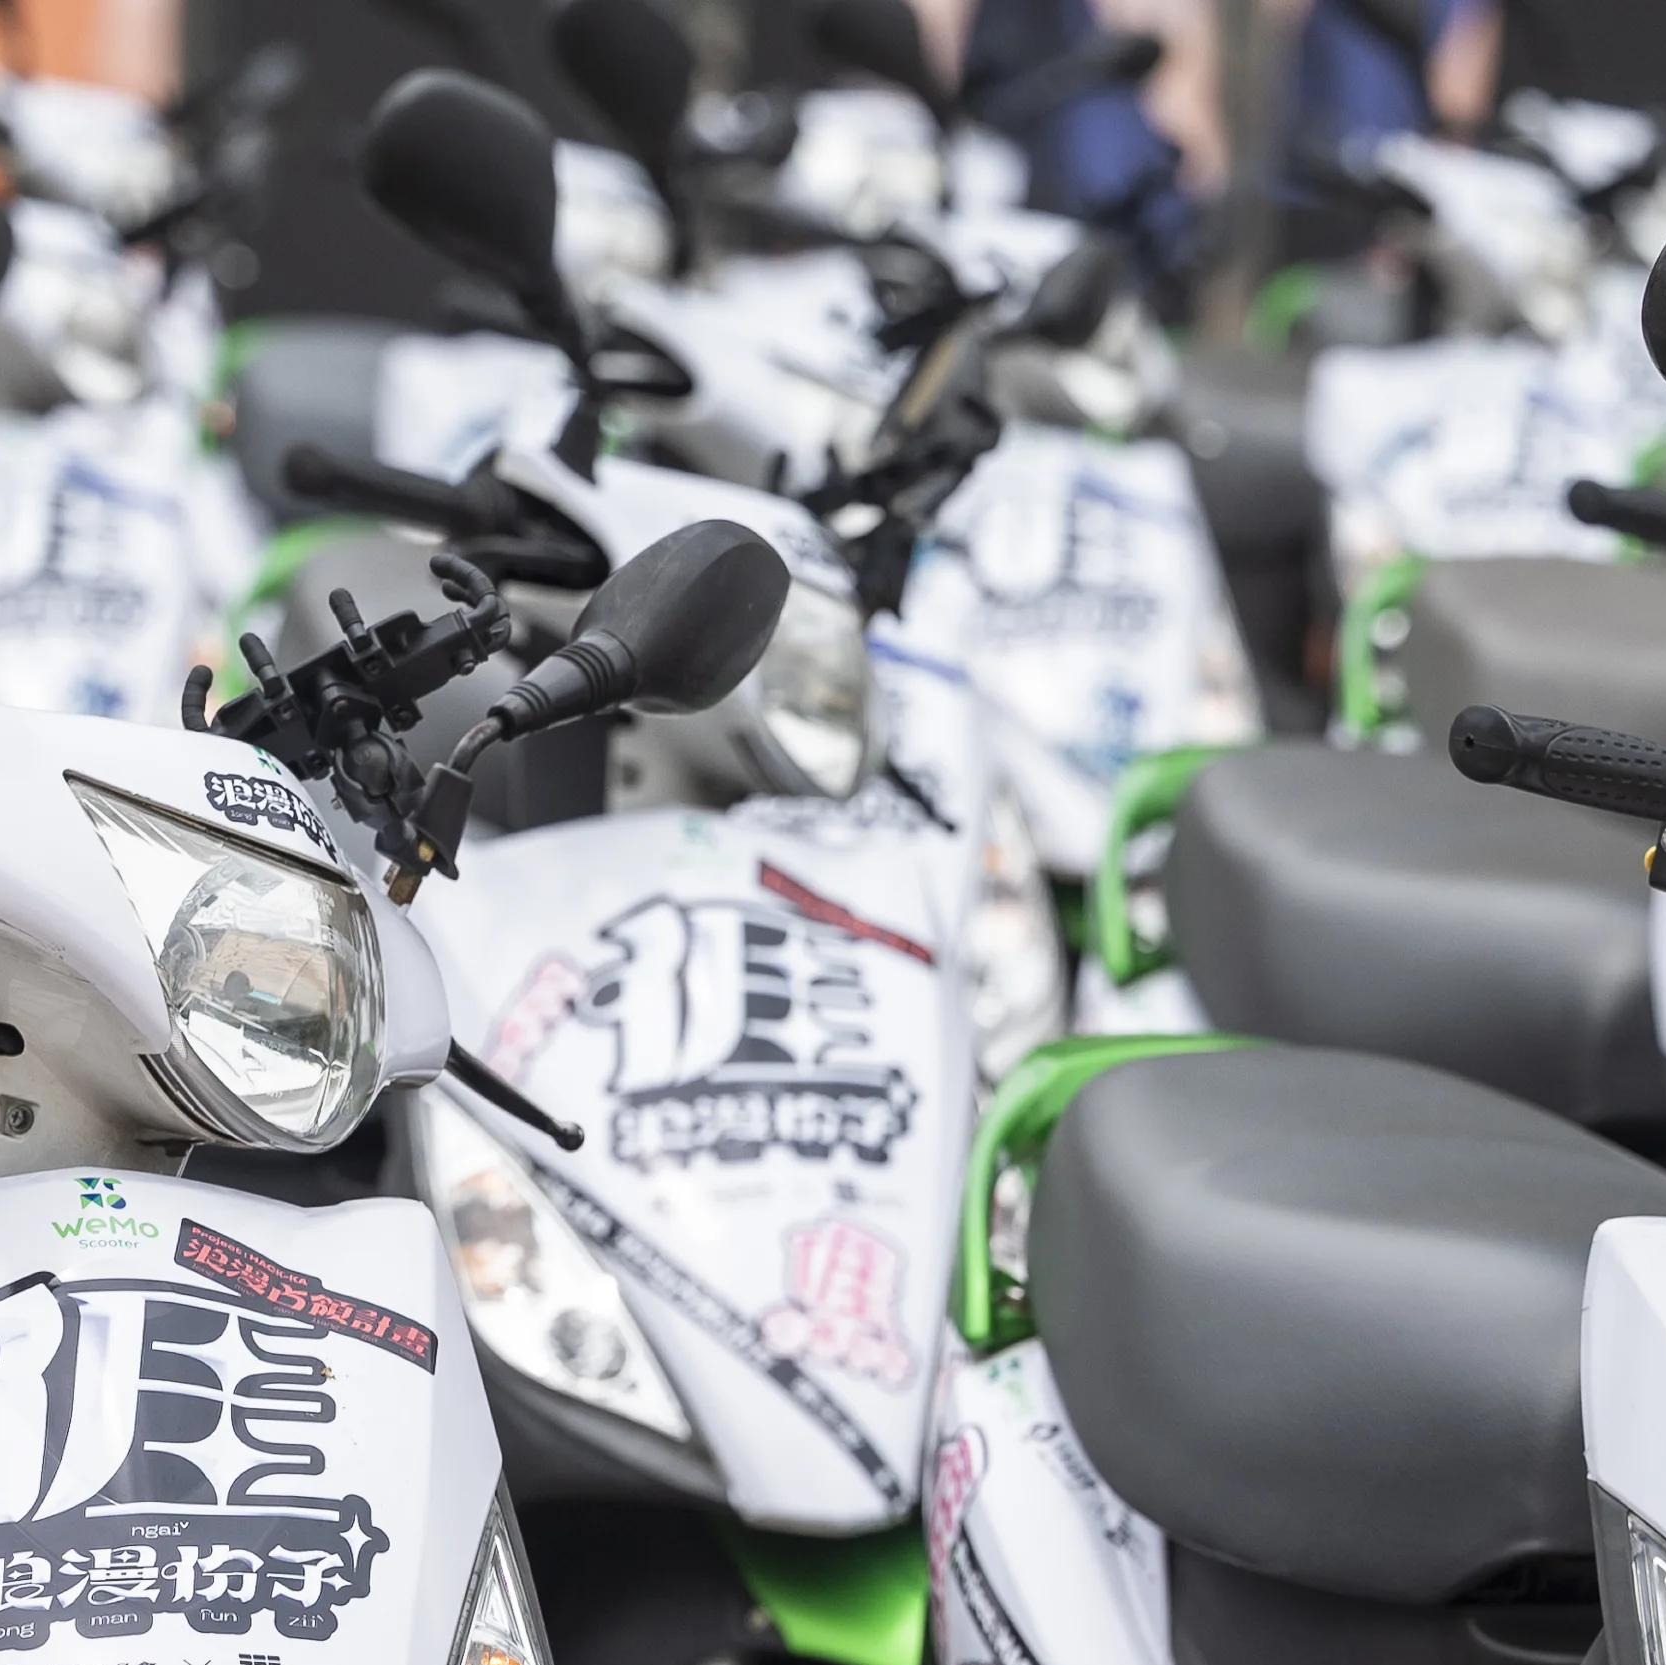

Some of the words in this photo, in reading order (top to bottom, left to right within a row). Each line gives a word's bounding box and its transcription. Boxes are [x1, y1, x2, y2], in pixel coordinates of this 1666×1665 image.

[51, 1215, 160, 1240] WeMo
[78, 1238, 142, 1250] Scooter
[89, 1609, 140, 1627] man
[198, 1606, 239, 1624] fun
